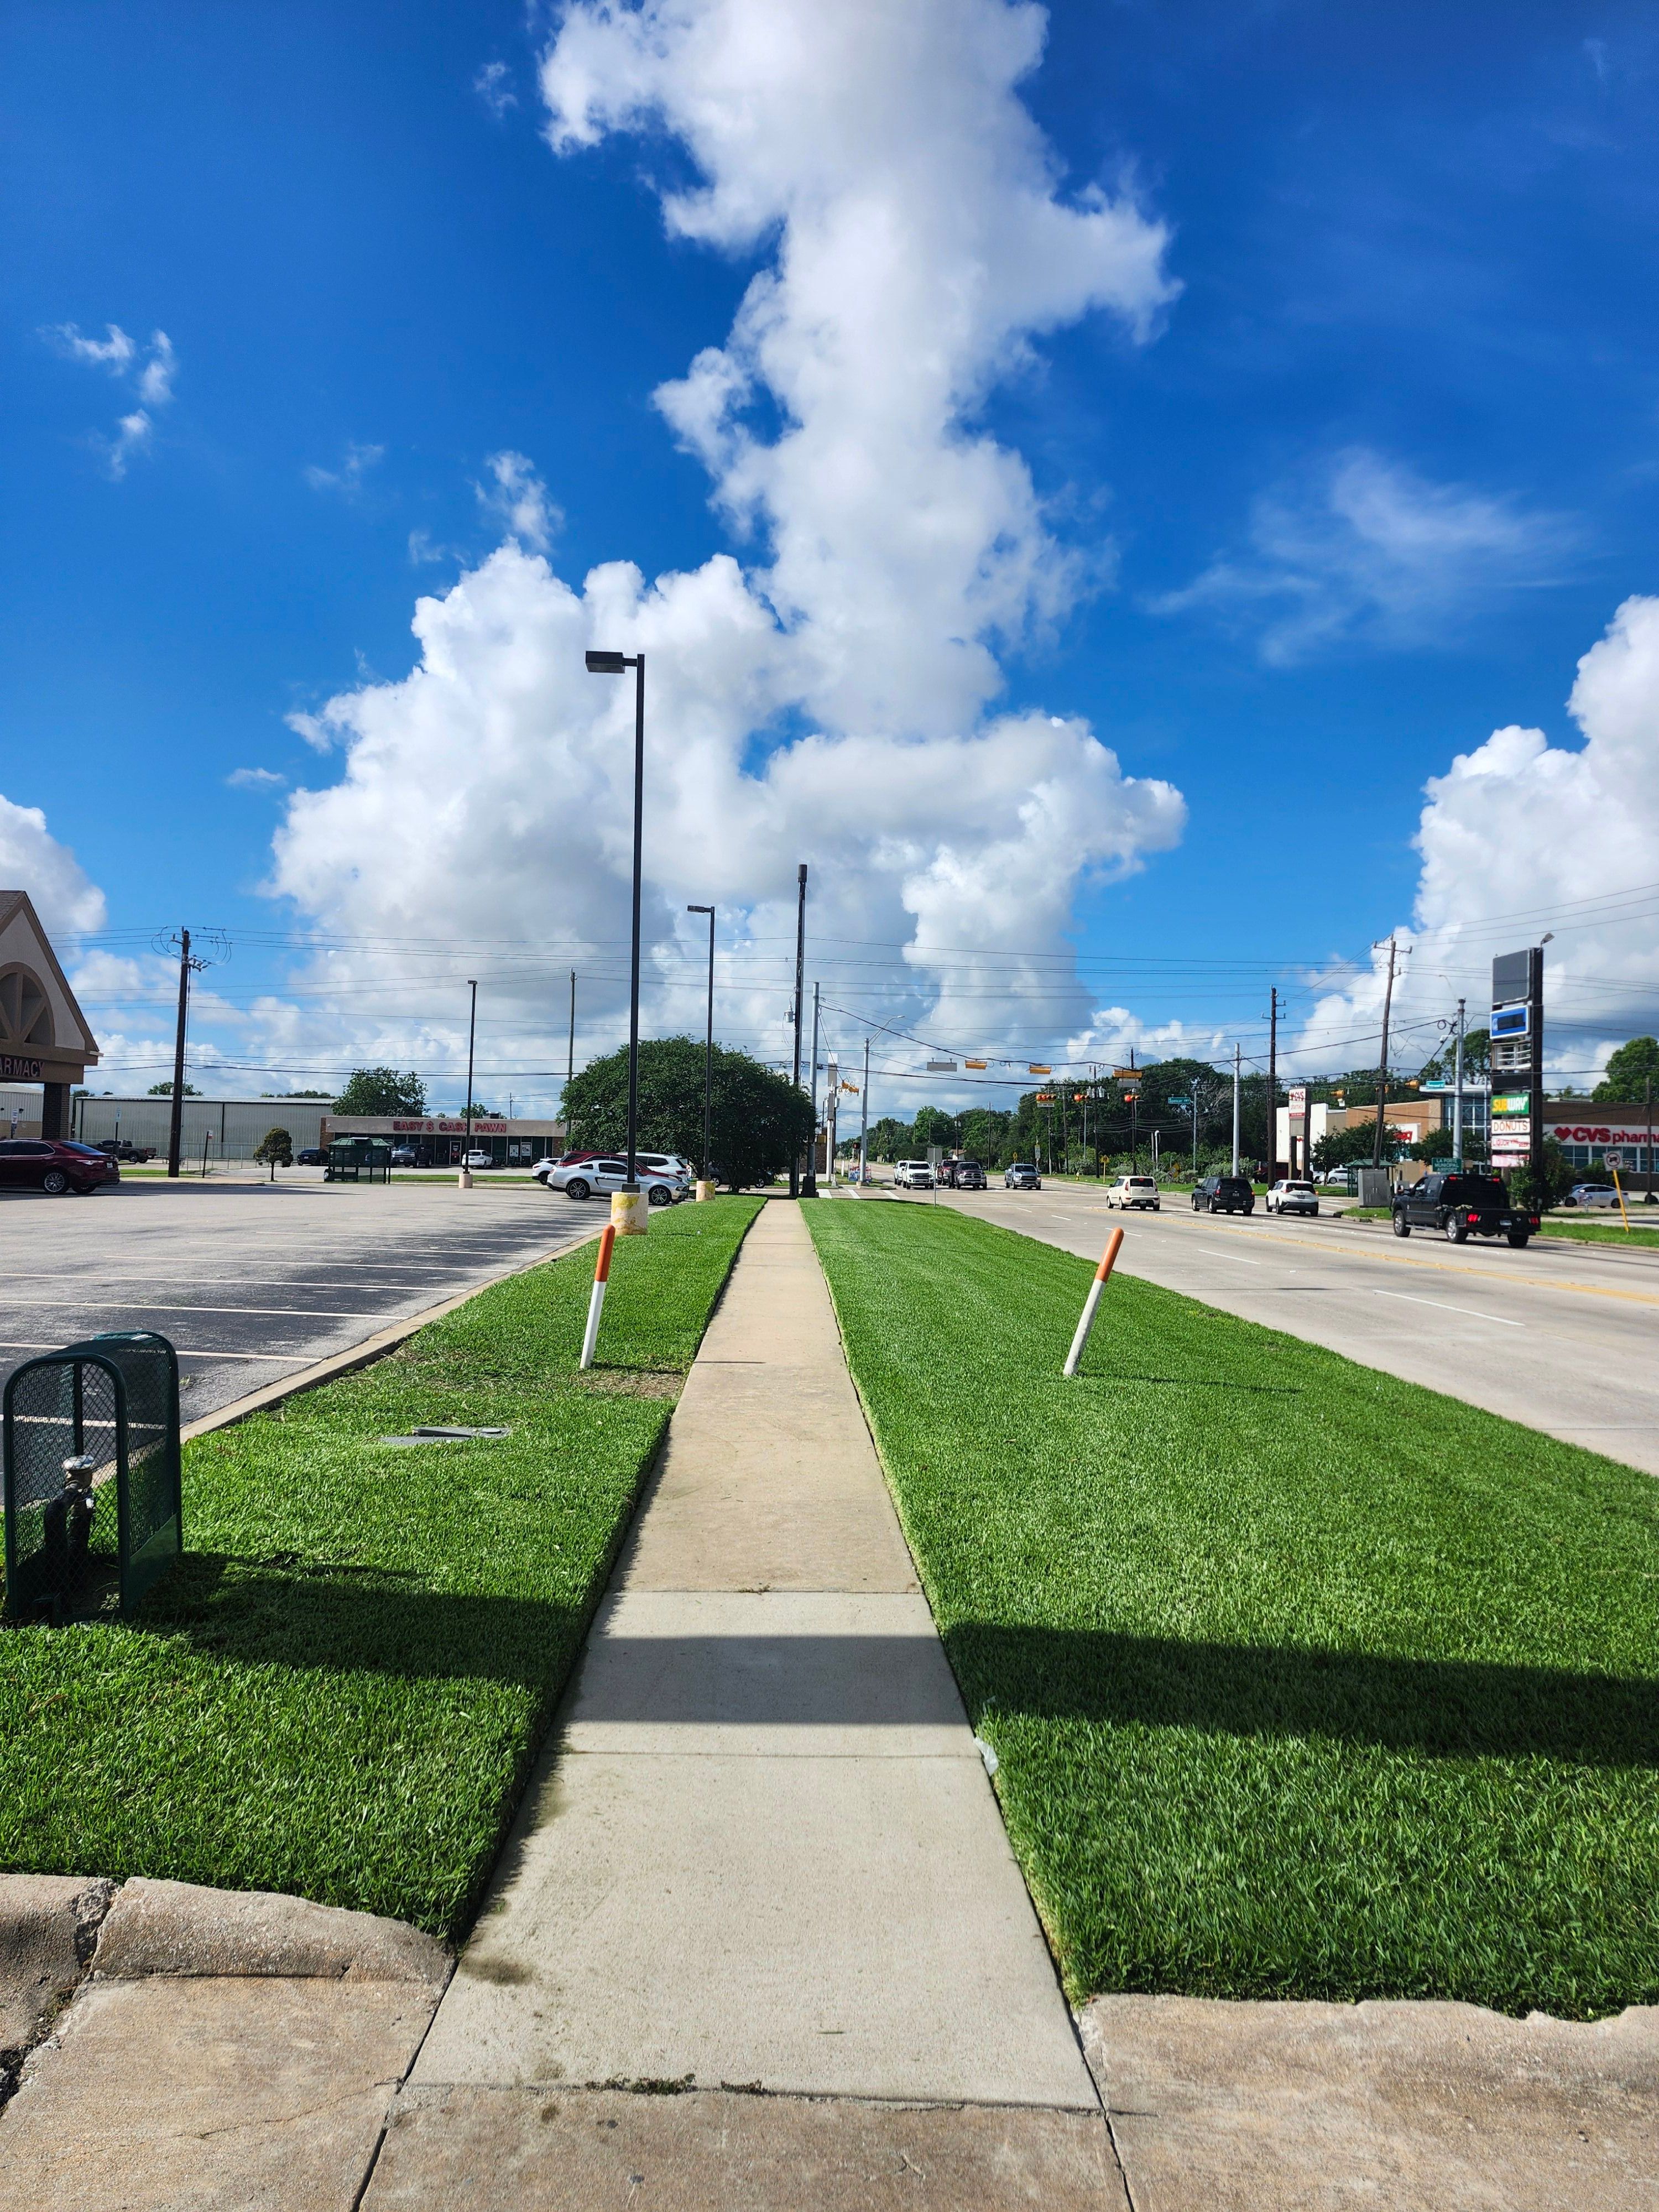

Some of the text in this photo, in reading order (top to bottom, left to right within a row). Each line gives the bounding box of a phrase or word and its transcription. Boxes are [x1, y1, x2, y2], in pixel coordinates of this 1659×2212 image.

[1295, 1091, 1304, 1101] CVS
[1492, 1096, 1528, 1112] SUBWAY
[393, 1121, 424, 1131] EASY
[426, 1120, 434, 1132] $
[474, 1123, 507, 1133] PAWN
[1494, 1121, 1528, 1131] DONUTS
[1572, 1126, 1611, 1142] CVS
